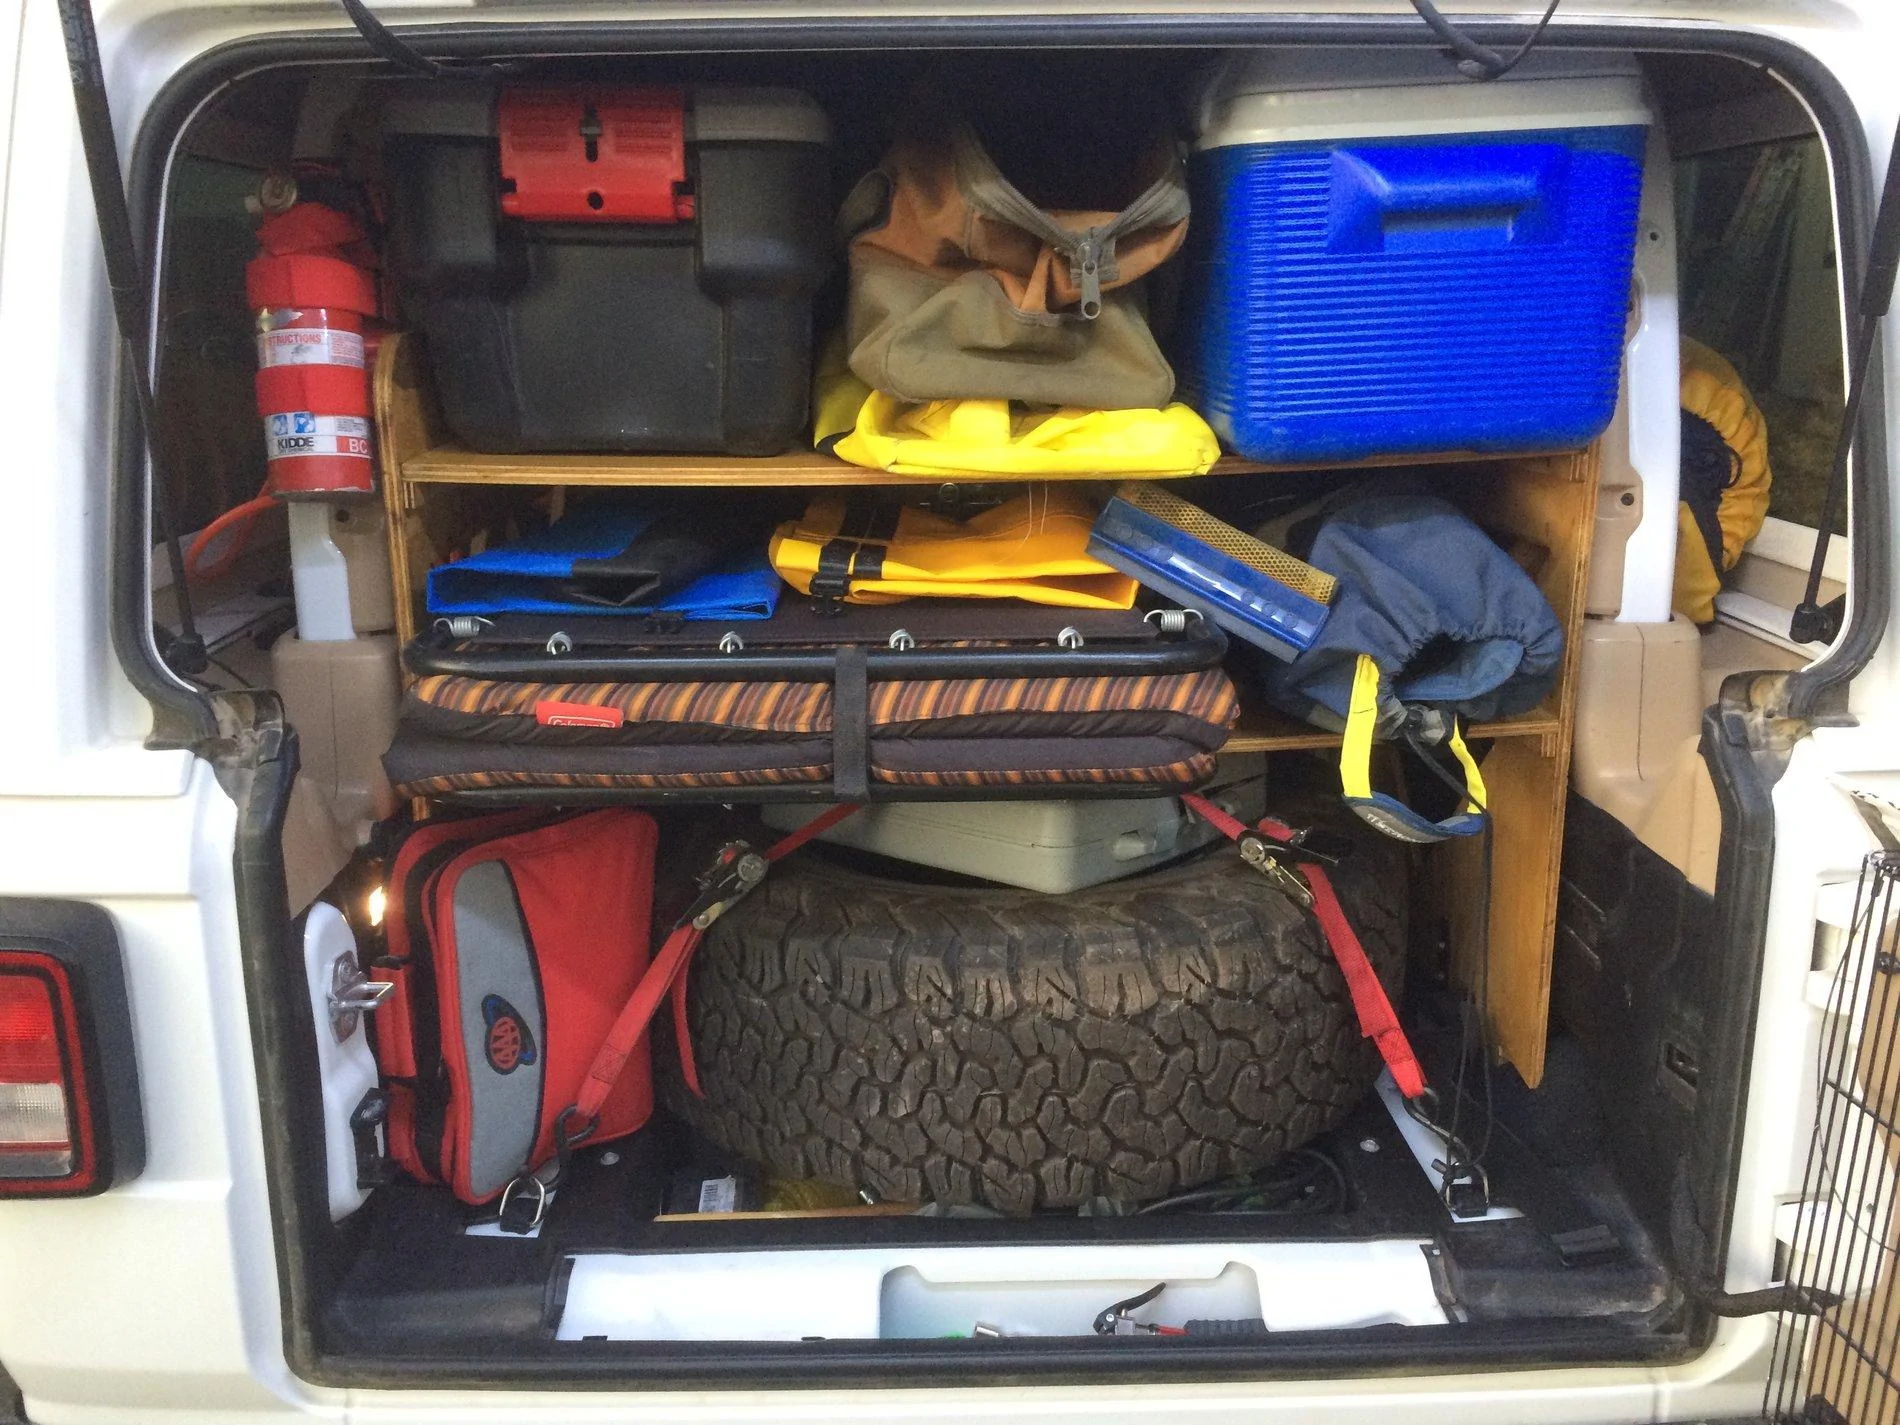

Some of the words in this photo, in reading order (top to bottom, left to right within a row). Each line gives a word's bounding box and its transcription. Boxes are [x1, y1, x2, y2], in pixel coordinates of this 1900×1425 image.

[266, 333, 321, 345] STRUCTIONS
[277, 436, 315, 450] KIDDE
[348, 438, 368, 454] BC
